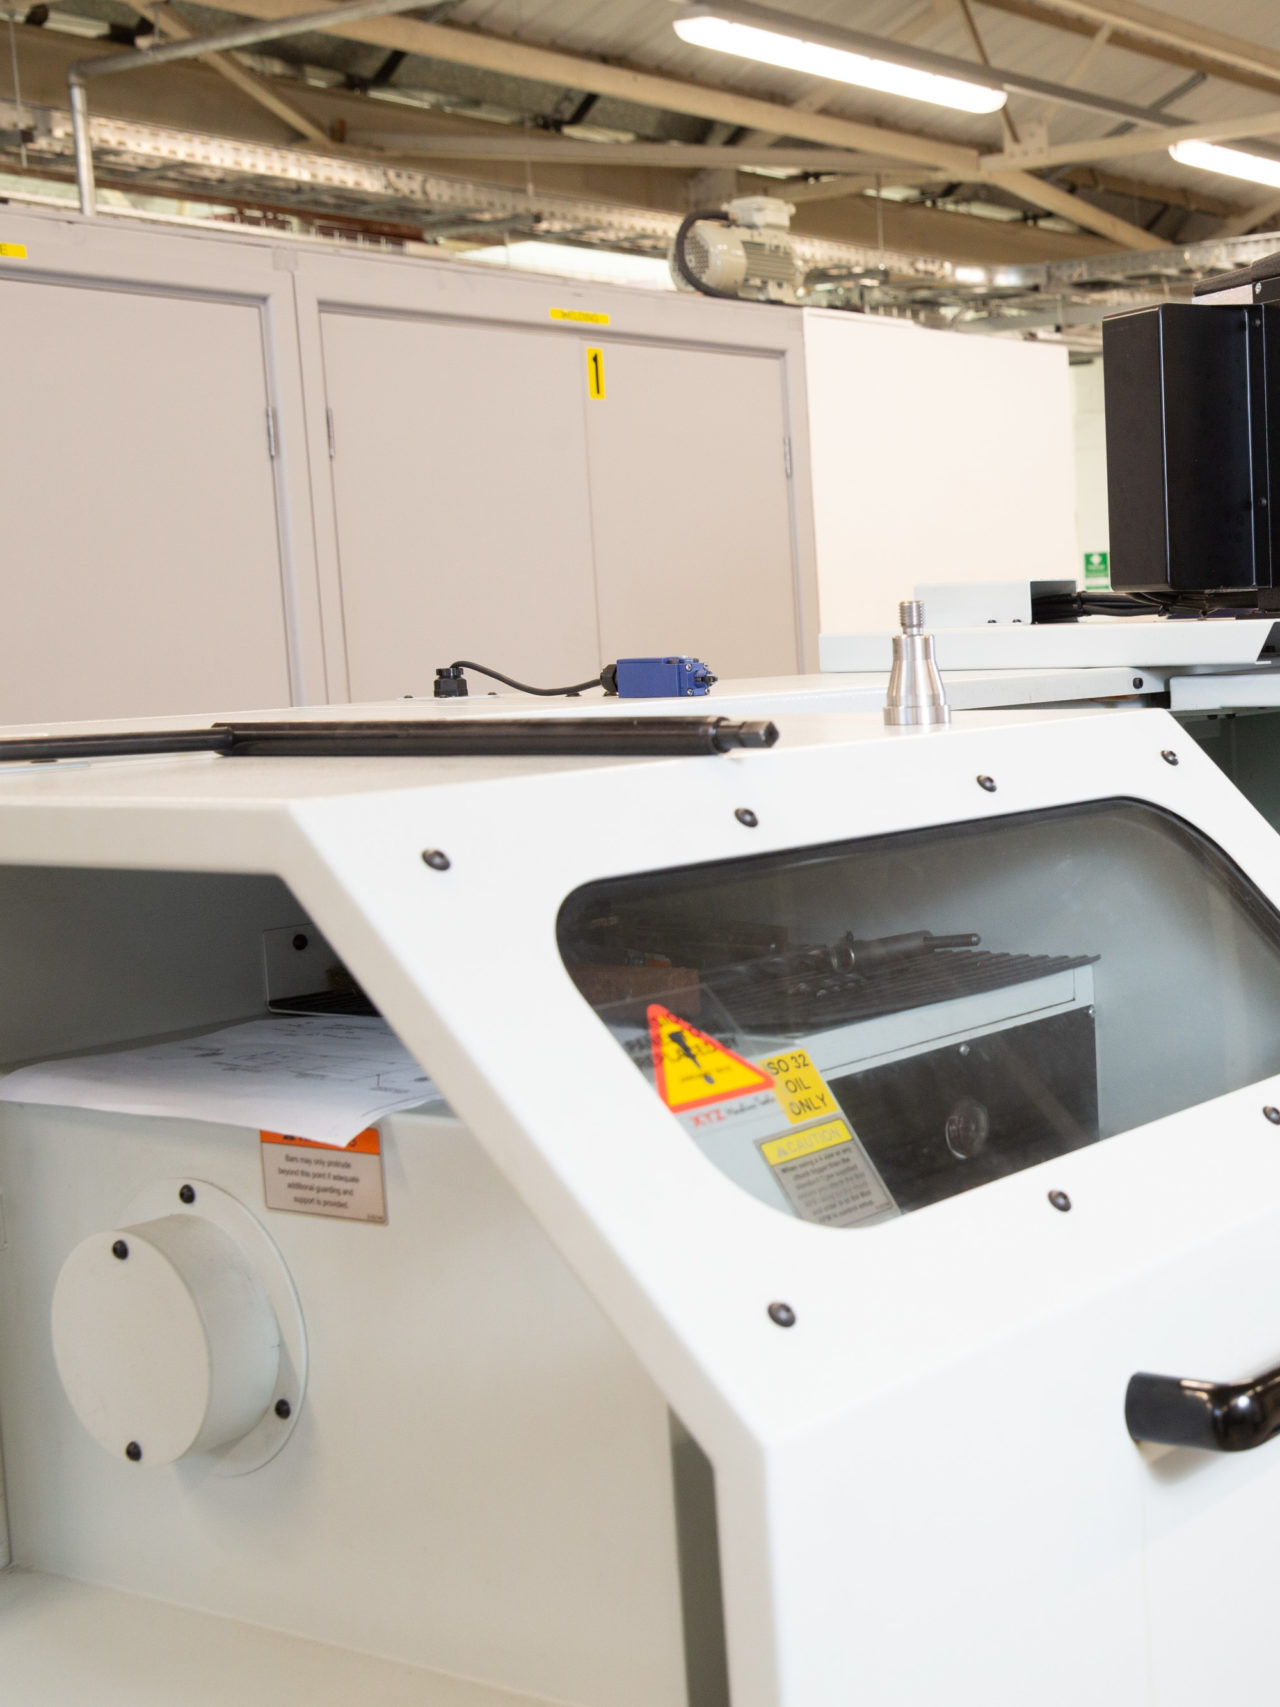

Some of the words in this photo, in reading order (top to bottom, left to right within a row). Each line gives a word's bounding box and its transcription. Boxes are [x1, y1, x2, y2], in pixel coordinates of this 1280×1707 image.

[592, 353, 600, 394] 1
[790, 1054, 809, 1069] 32
[785, 1077, 811, 1093] OIL
[789, 1093, 827, 1116] ONLY
[690, 1108, 727, 1129] XYZ
[786, 1127, 842, 1153] CAUTION
[300, 1157, 312, 1166] may
[314, 1158, 326, 1167] only
[326, 1160, 352, 1169] protrude
[278, 1167, 299, 1178] beyond
[301, 1169, 311, 1177] this
[311, 1171, 328, 1180] point
[332, 1175, 360, 1184] adequate
[287, 1181, 315, 1192] additional
[315, 1185, 342, 1197] guarding
[342, 1188, 354, 1197] and
[293, 1195, 315, 1206] support
